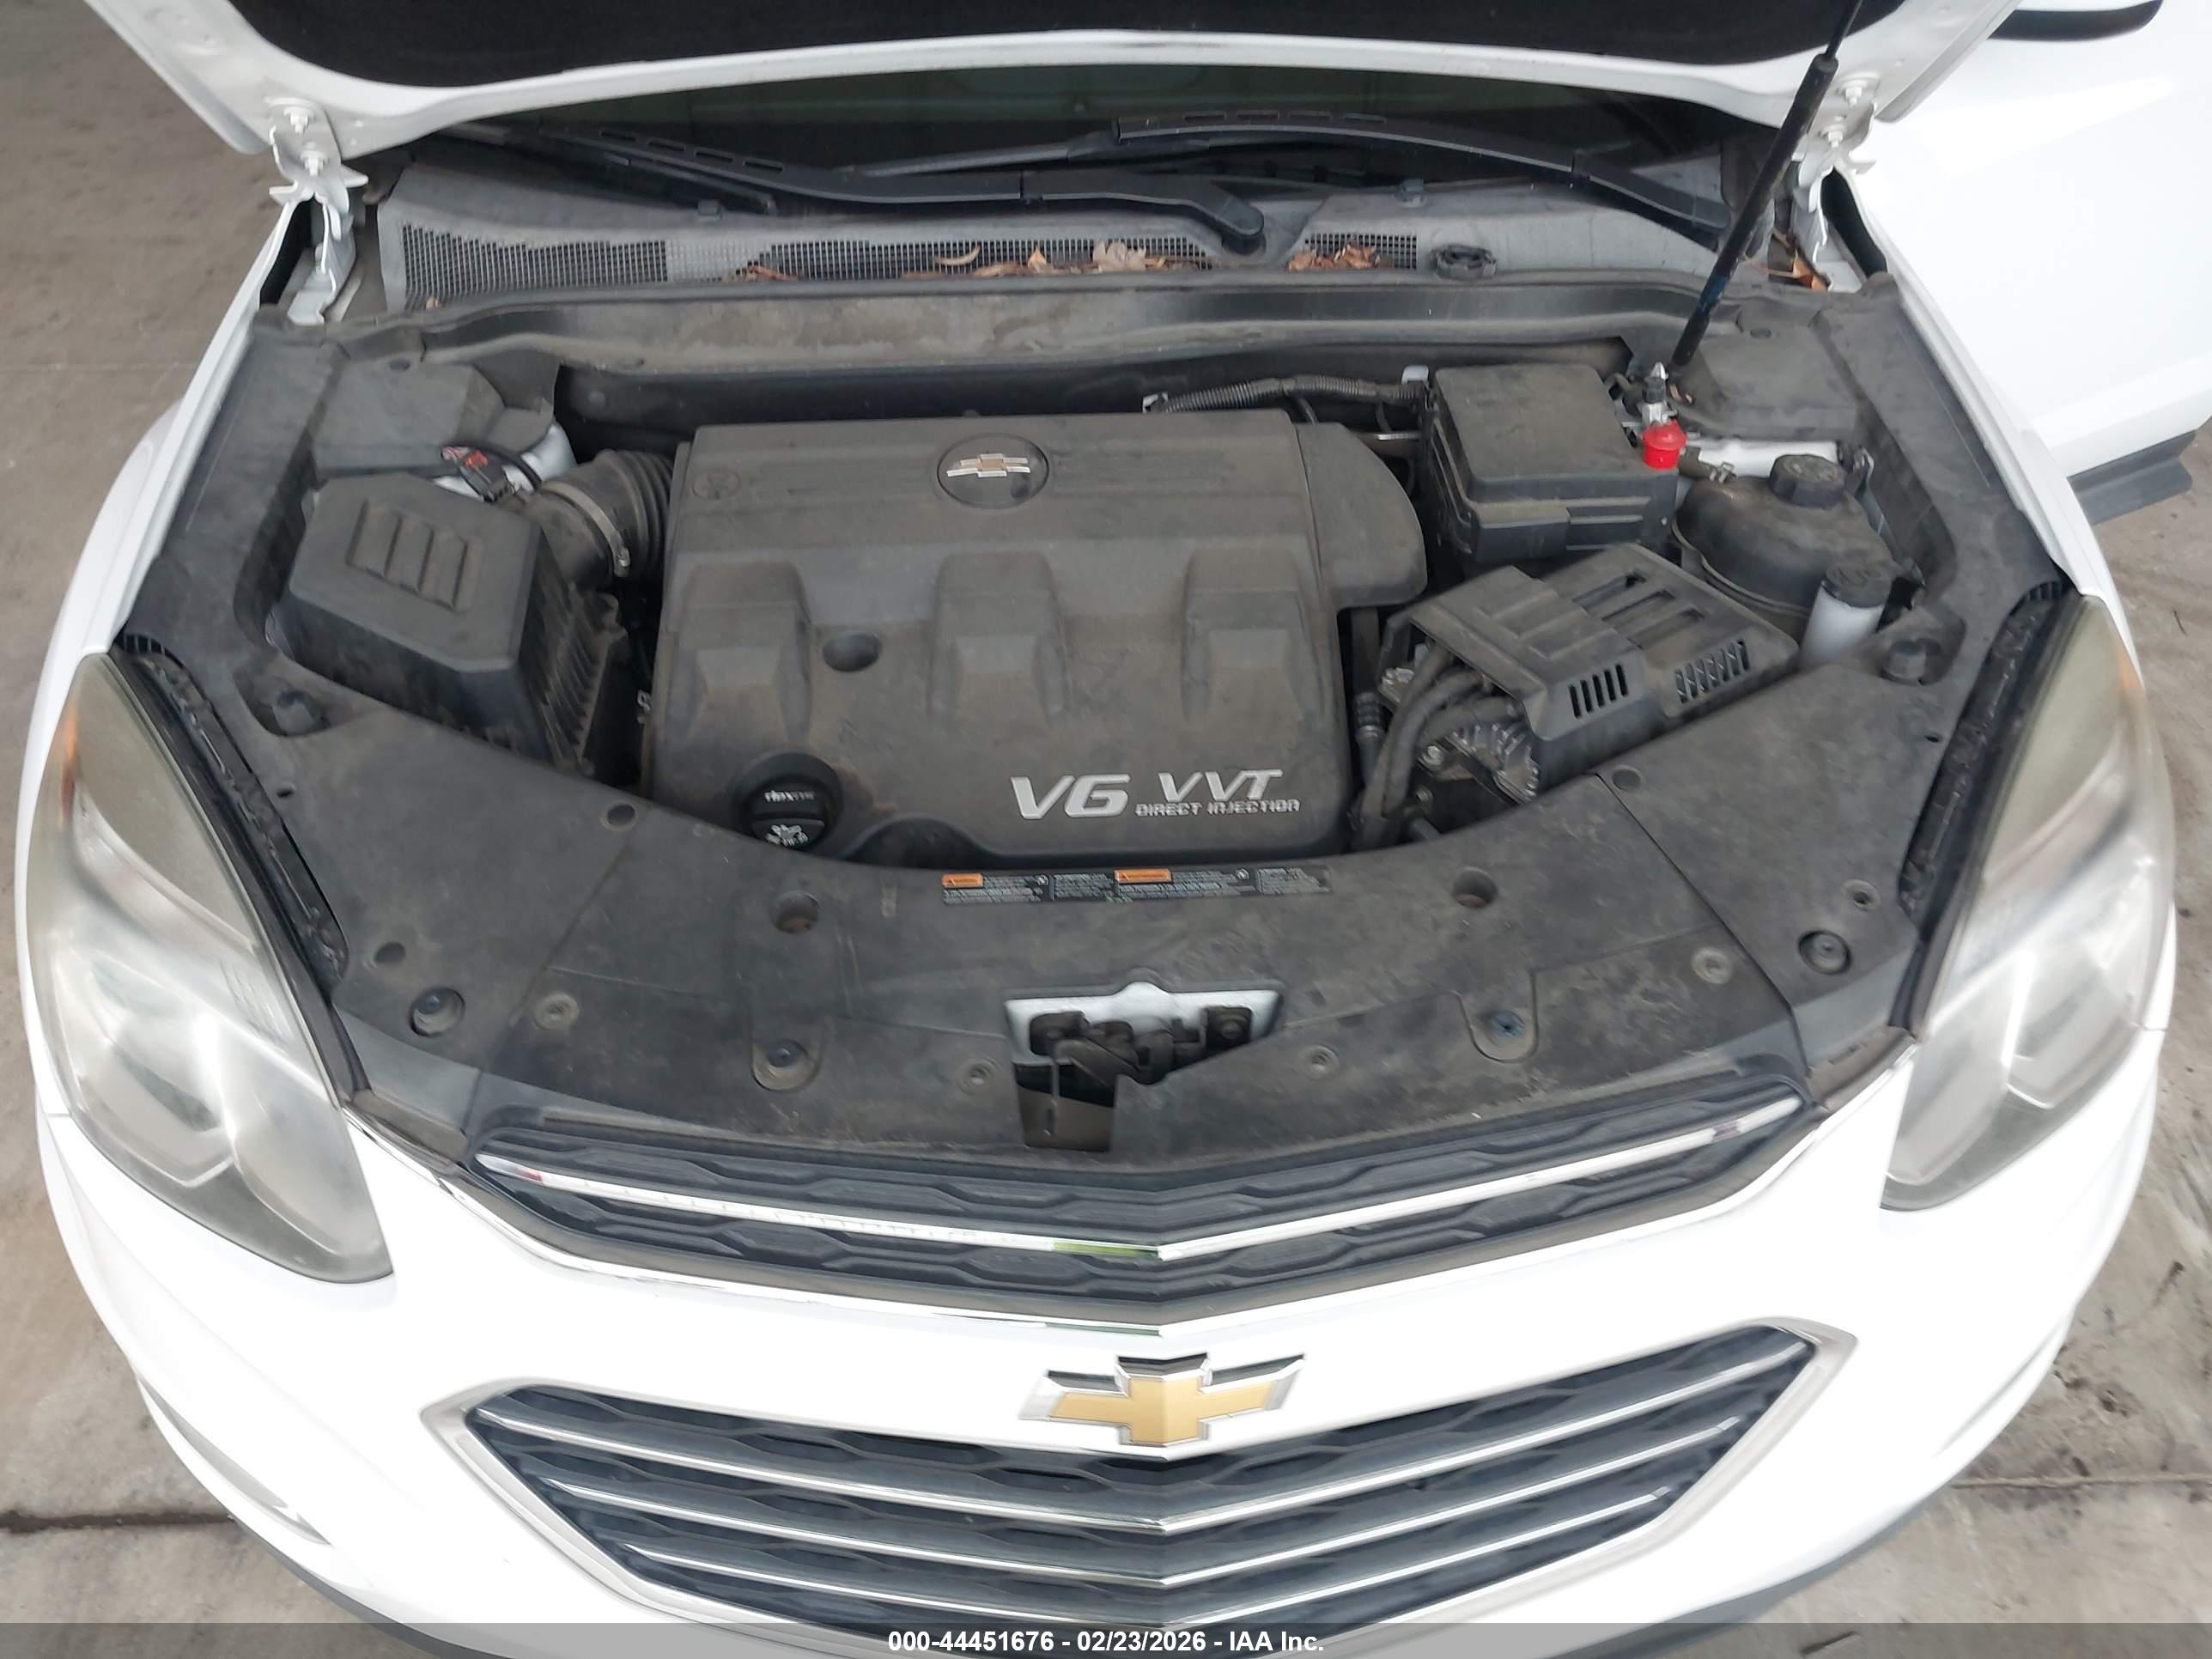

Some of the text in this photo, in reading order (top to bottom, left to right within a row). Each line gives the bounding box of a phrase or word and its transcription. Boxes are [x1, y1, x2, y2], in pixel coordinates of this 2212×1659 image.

[1011, 769, 1284, 819] V6 VVT
[1135, 799, 1301, 817] DIRECT INJECTION
